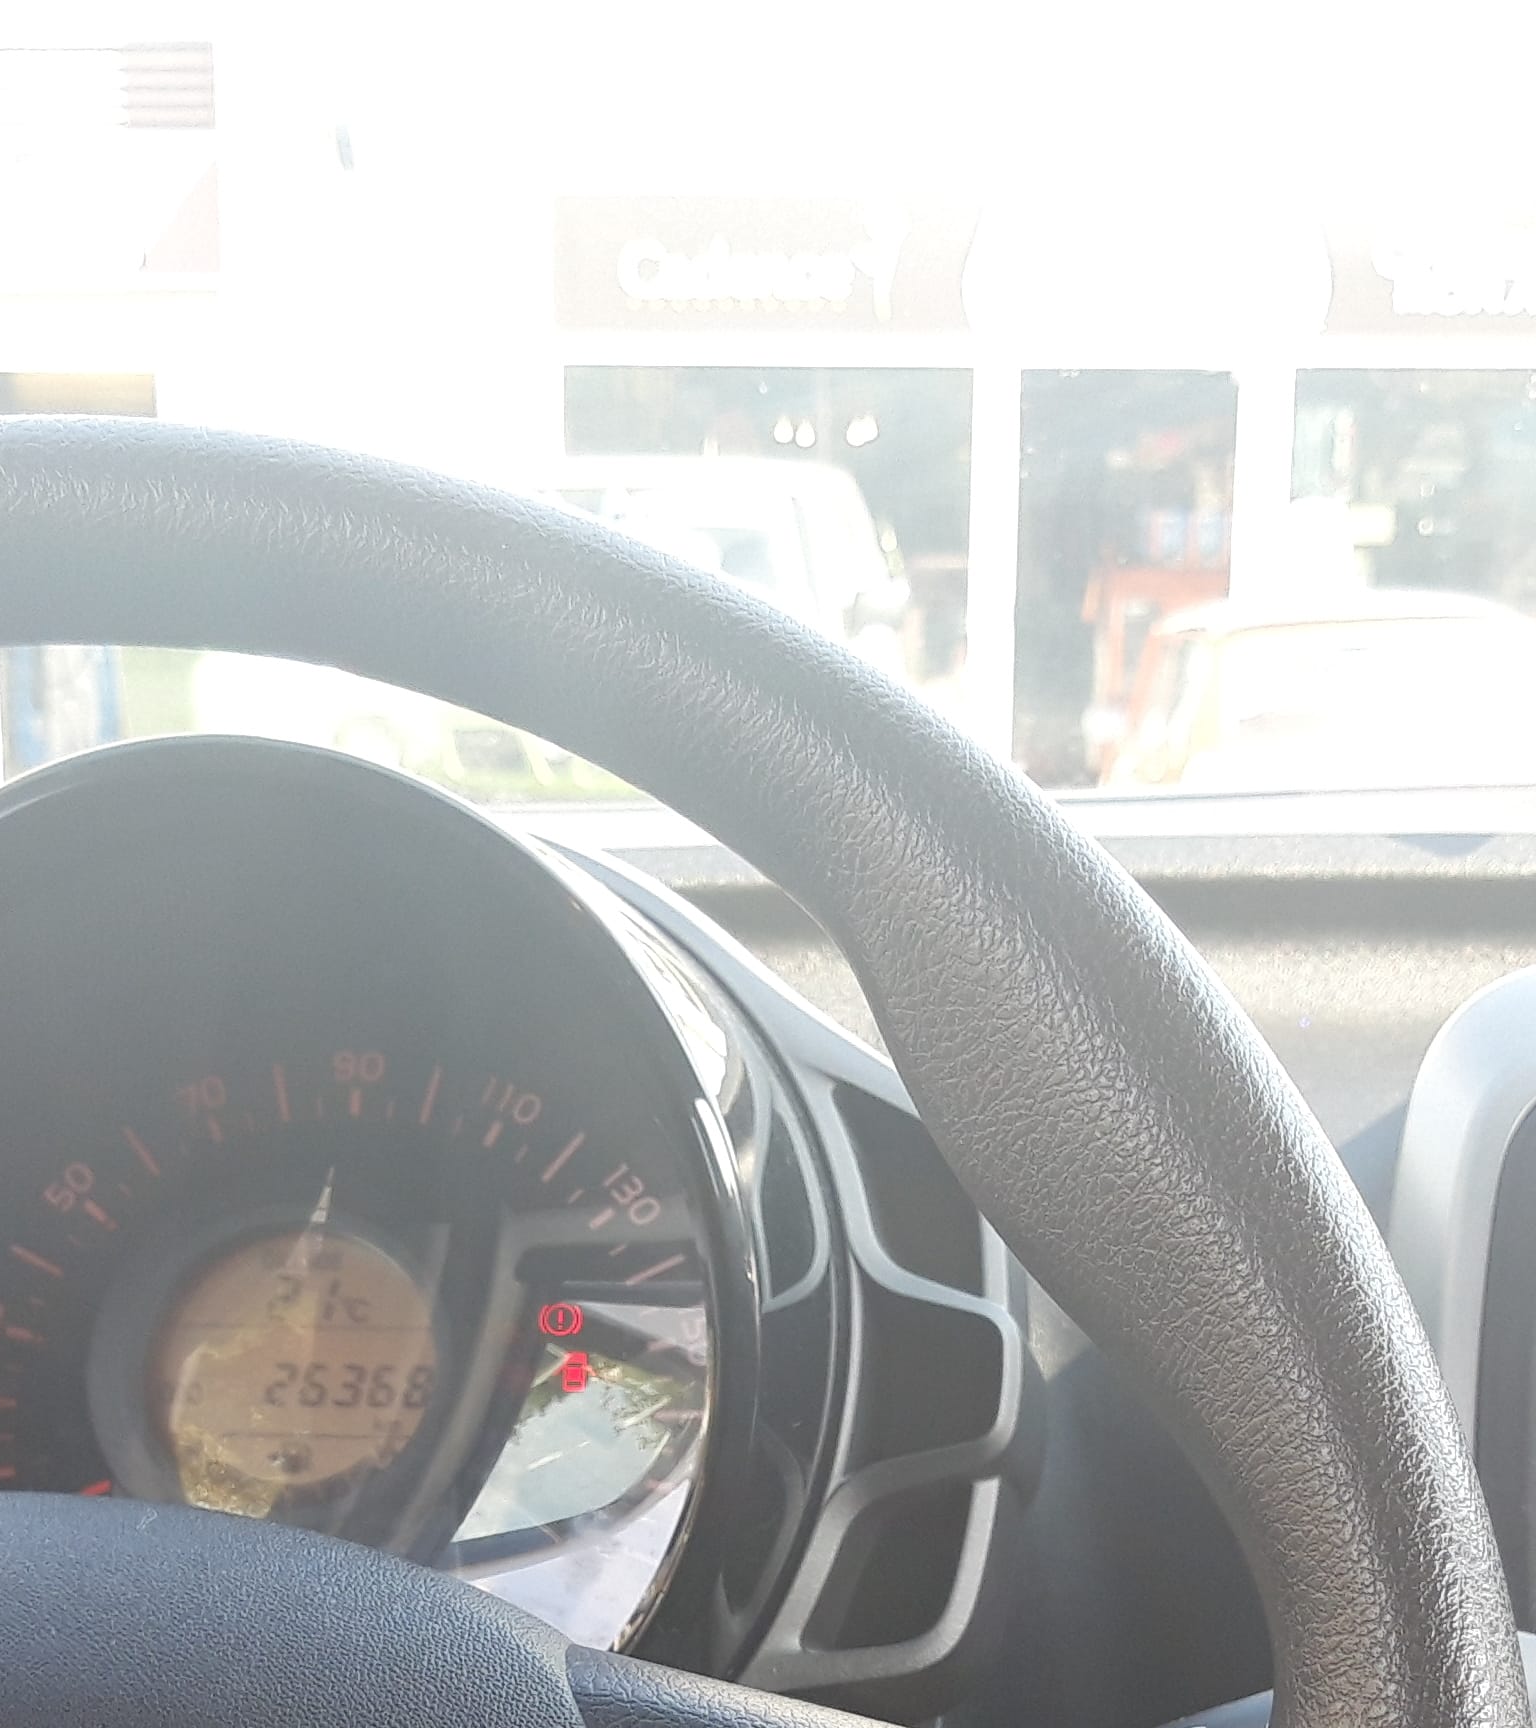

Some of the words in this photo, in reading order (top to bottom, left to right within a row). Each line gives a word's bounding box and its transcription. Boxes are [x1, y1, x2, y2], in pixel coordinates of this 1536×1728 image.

[481, 1075, 543, 1124] 110
[42, 1161, 97, 1213] 50
[602, 1163, 662, 1226] 130
[264, 1362, 434, 1409] 26368
